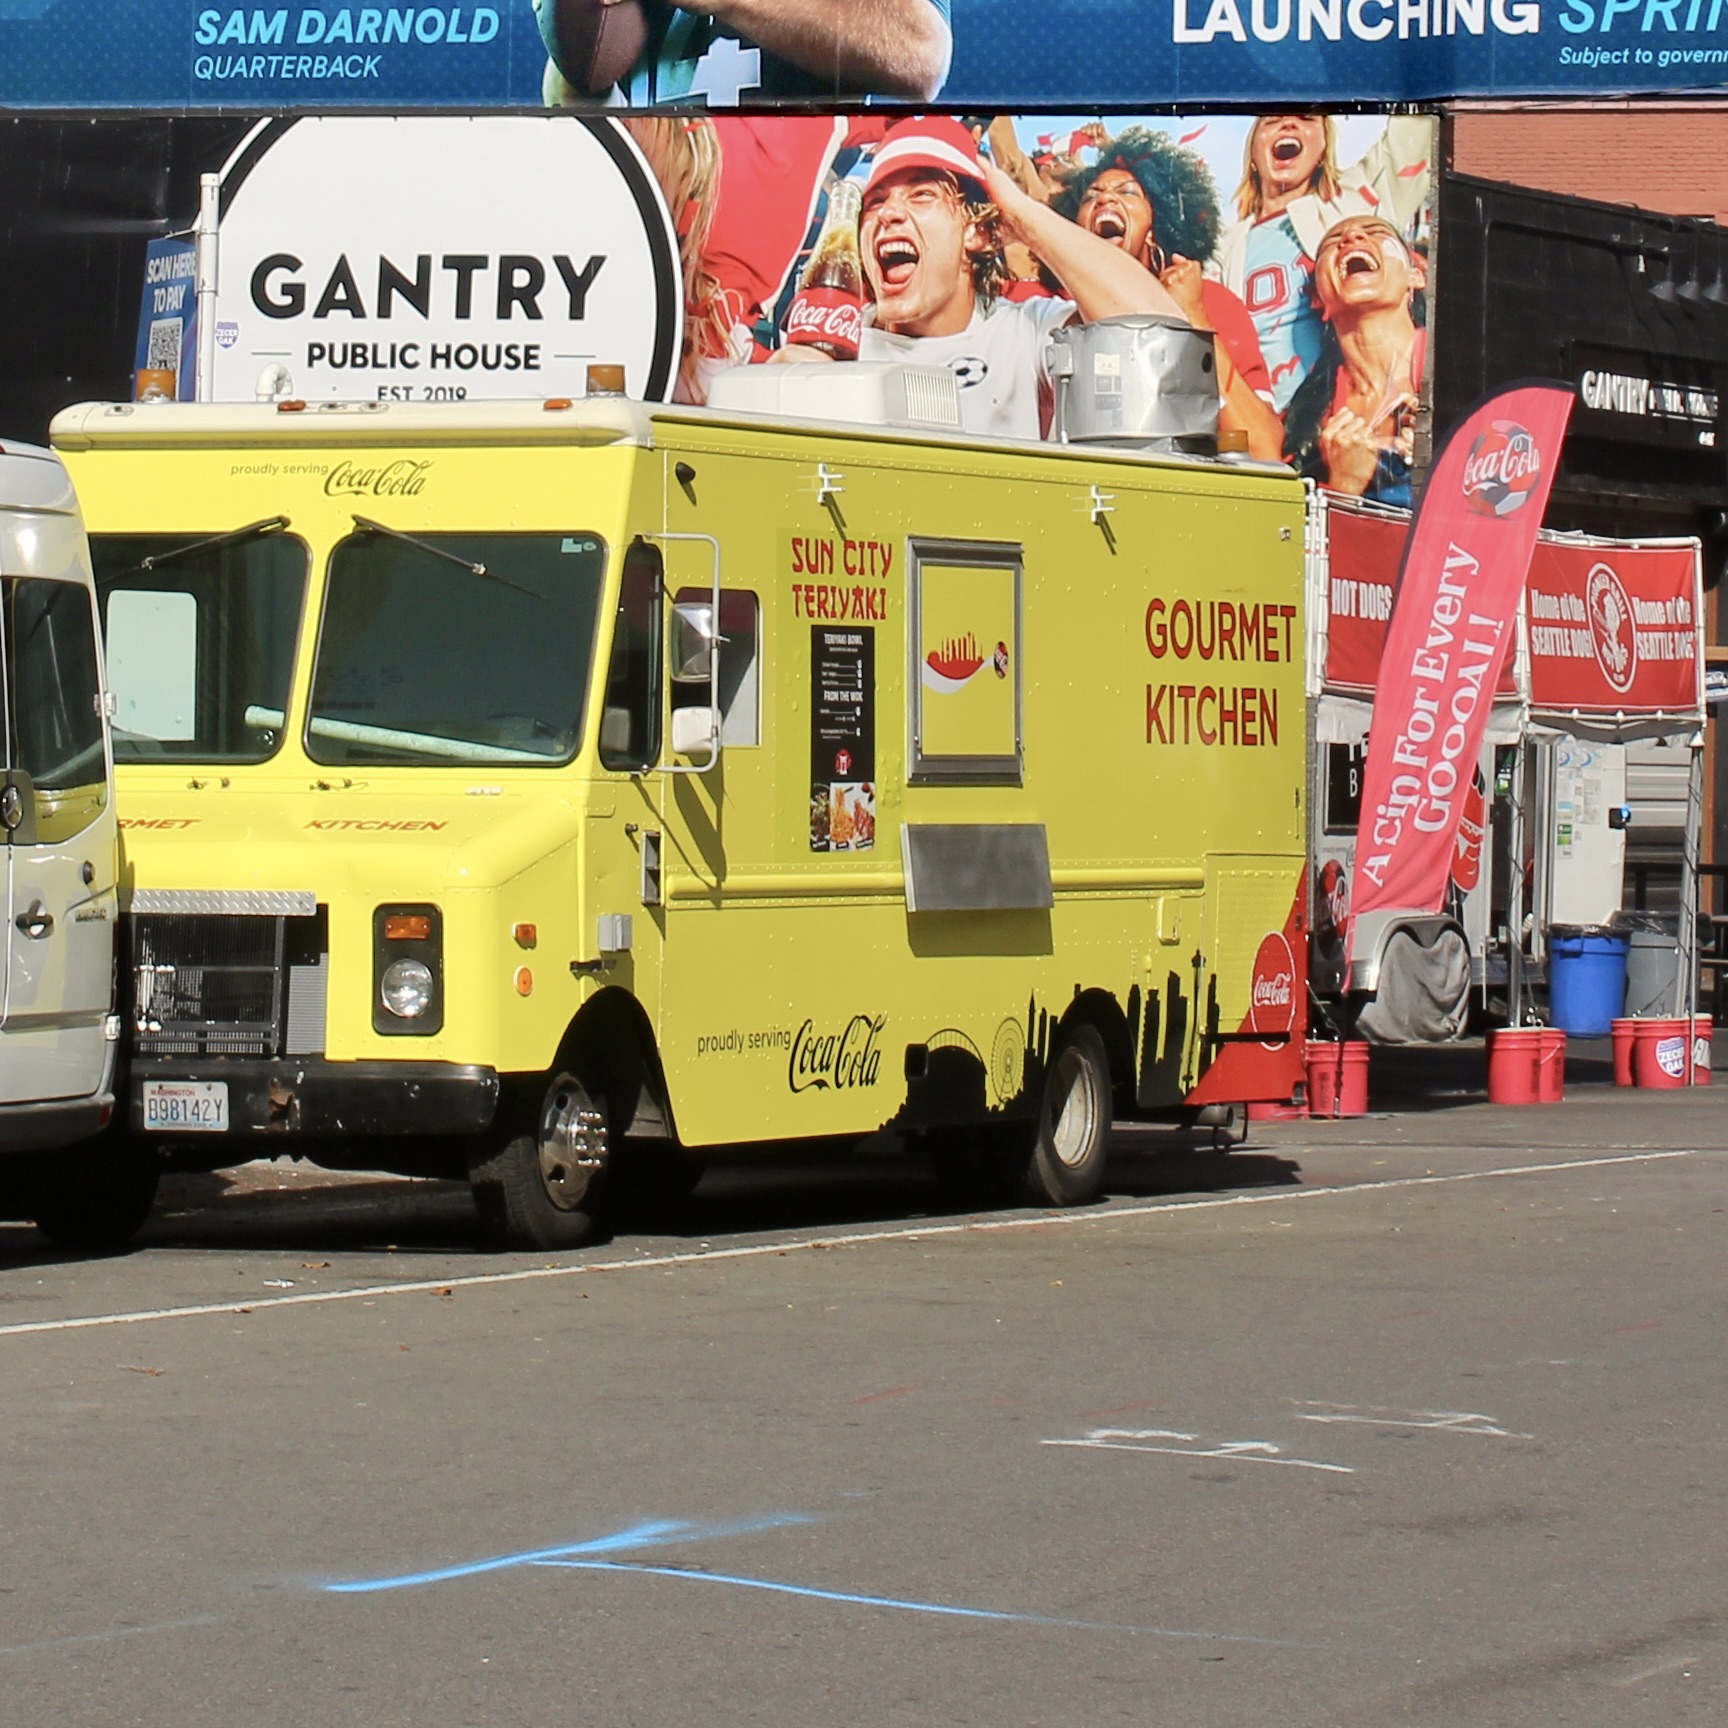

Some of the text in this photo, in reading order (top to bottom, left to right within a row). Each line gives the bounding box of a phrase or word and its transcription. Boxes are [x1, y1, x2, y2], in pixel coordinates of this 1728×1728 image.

[195, 8, 499, 45] SAM DARNOLD
[194, 55, 381, 81] QUARTERBACK
[1559, 46, 1630, 67] Subject
[1635, 48, 1653, 64] to
[147, 251, 196, 284] SCAN HERE
[153, 284, 186, 314] TO PAY
[250, 252, 608, 321] GANTRY
[787, 298, 860, 344] Coca-Cola
[307, 342, 541, 370] PUBLIC HOUSE
[1582, 370, 1650, 415] GANTRY
[231, 460, 435, 497] proudly serving Coca-Cola
[1462, 434, 1540, 496] Coca-Cola
[791, 537, 892, 578] SUN CITY
[792, 584, 887, 622] TERIYAKI
[1331, 579, 1392, 621] HOT DOGS
[1412, 542, 1480, 683] Every
[1531, 589, 1586, 622] Home of the
[1632, 597, 1665, 624] Home
[1666, 597, 1676, 624] of
[1145, 597, 1297, 665] GOURMET
[1532, 626, 1571, 656] SEATTLE
[1636, 632, 1673, 660] SEATTLE
[1145, 683, 1278, 748] KITCHEN
[1392, 690, 1440, 769] For
[305, 818, 449, 832] KITCHEN
[1361, 853, 1391, 888] A
[697, 1013, 887, 1093] proudly serving Coca-Cola
[148, 1098, 223, 1122] B98142Y
[150, 1089, 196, 1097] WASHINGTON
